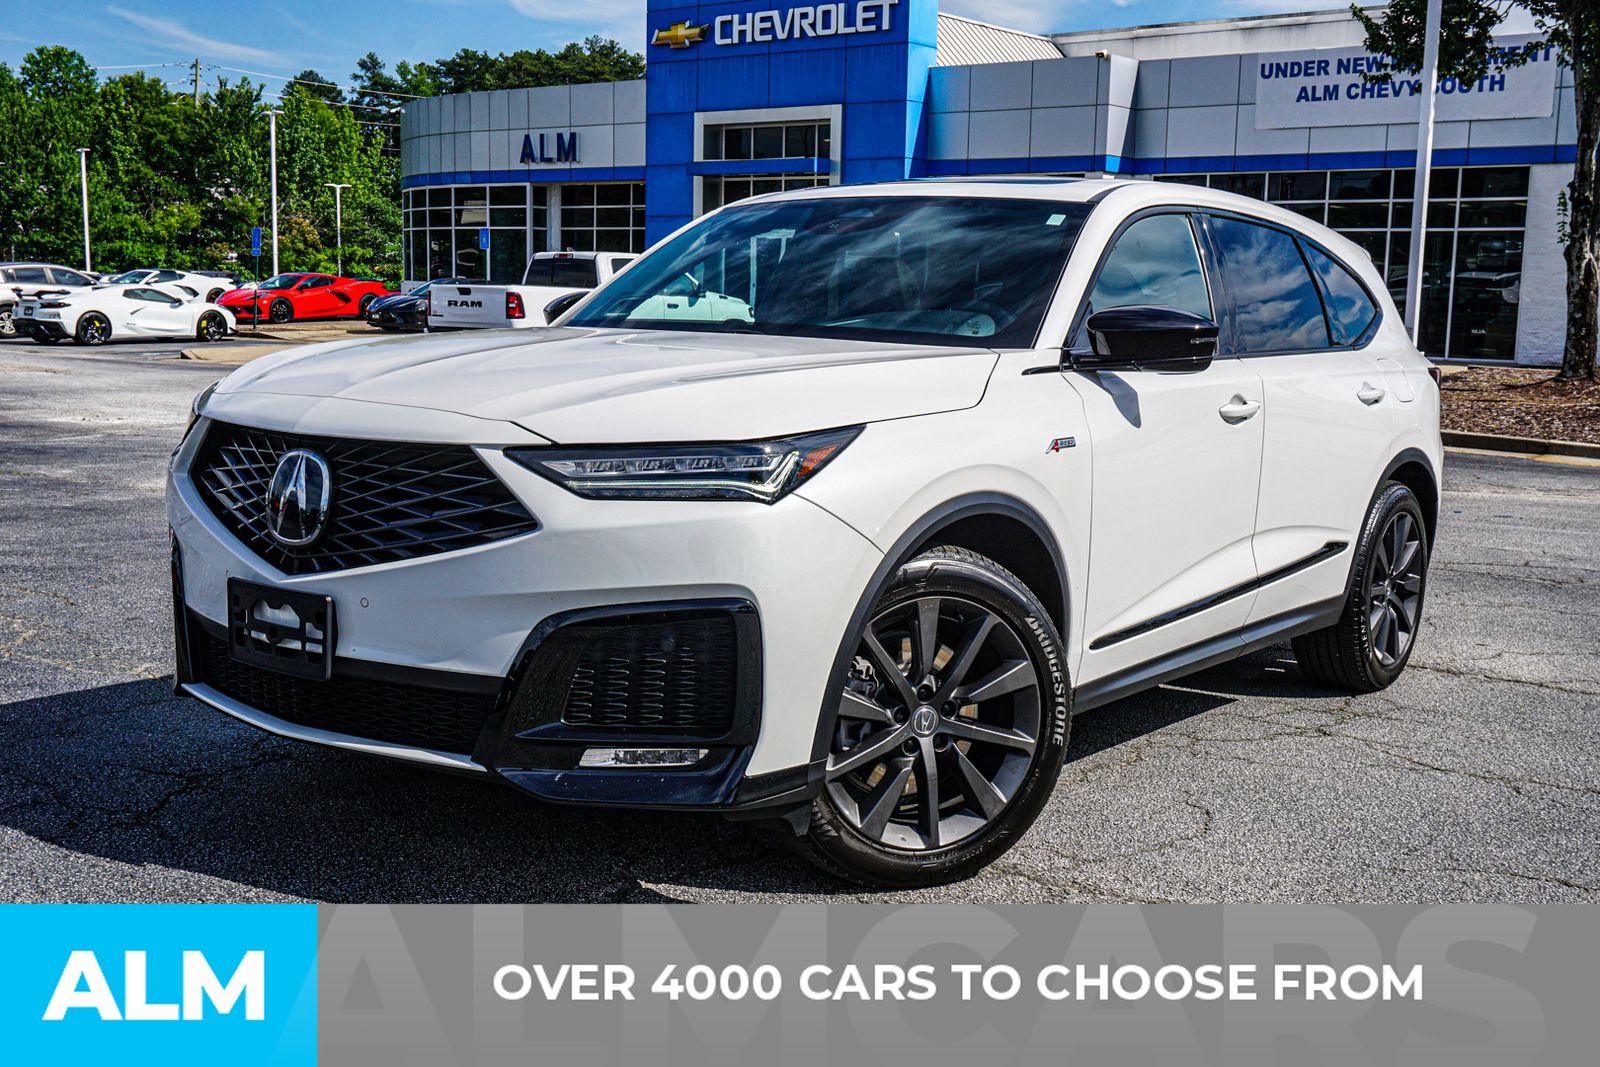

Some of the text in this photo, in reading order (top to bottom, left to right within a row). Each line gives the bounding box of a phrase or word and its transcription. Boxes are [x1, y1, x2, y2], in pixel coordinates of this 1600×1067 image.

[713, 0, 898, 46] CHEVROLET
[1260, 59, 1331, 80] UNDER
[1336, 54, 1387, 75] NEW
[1295, 73, 1506, 103] ALM CHEVY OUTH
[519, 131, 580, 164] ALM
[447, 299, 483, 308] RAM
[1024, 613, 1067, 746] BRIDGESTONE
